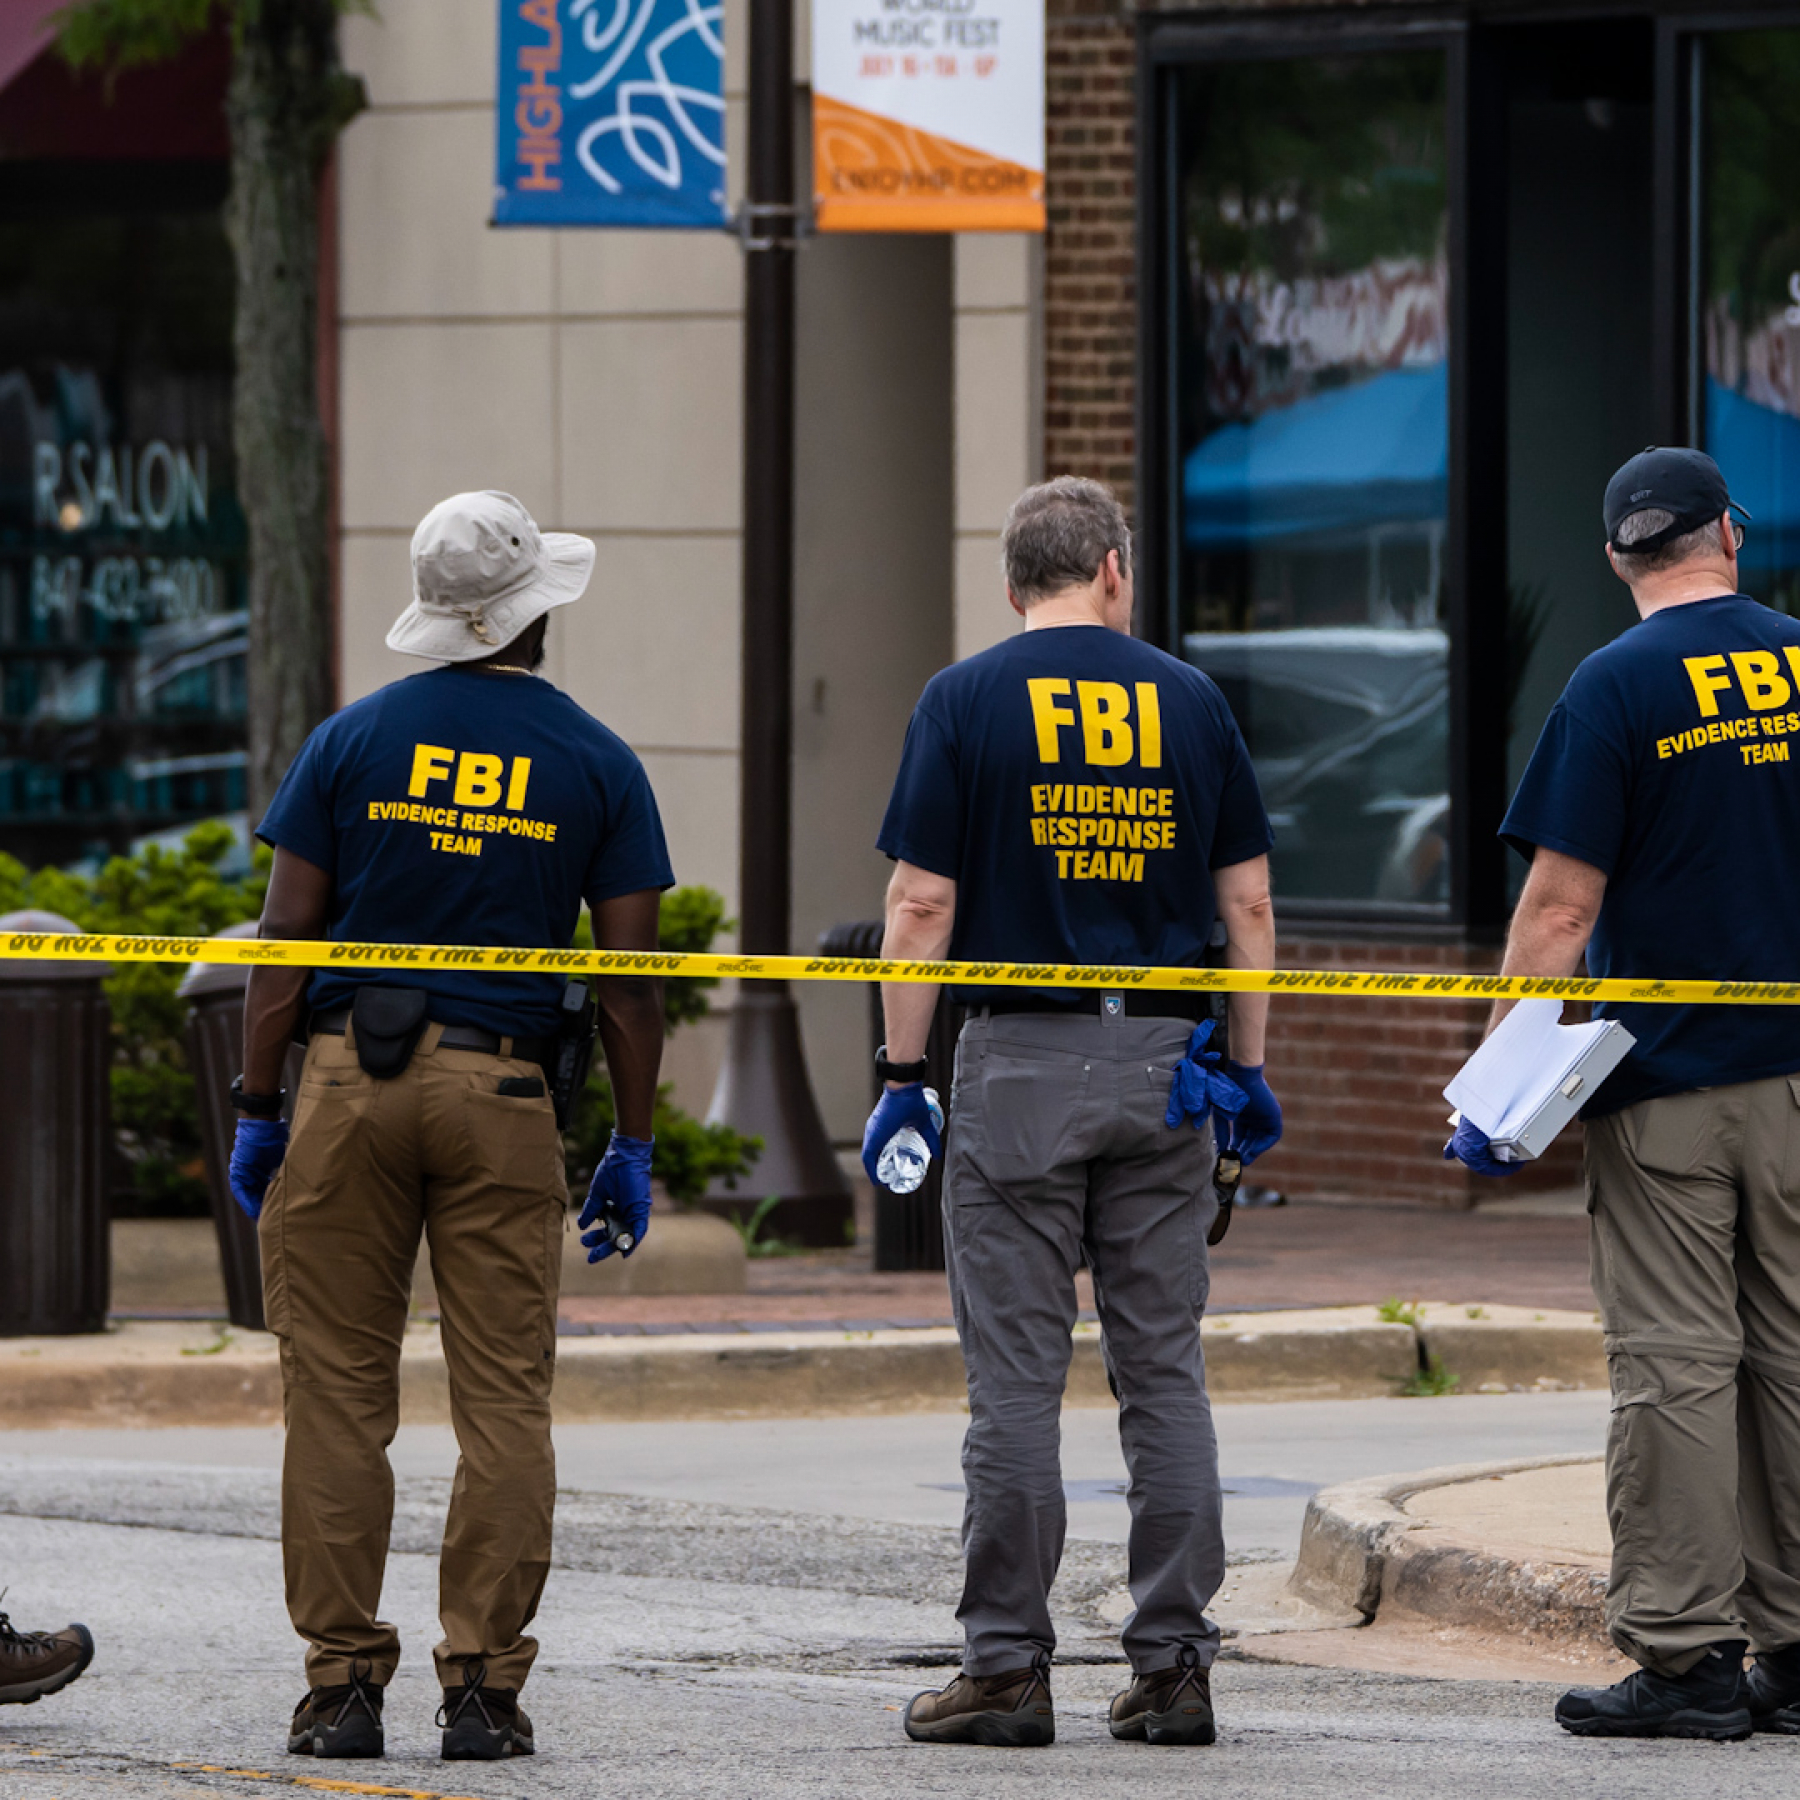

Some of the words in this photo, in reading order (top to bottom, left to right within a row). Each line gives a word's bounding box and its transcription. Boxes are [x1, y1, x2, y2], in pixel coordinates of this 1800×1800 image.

[853, 18, 935, 47] MUSIC
[943, 18, 999, 48] FEST
[1026, 677, 1162, 768] FBI
[1656, 717, 1758, 759] EVIDENCE
[1759, 712, 1800, 736] RES
[1740, 741, 1790, 765] TEAM
[408, 743, 532, 811] FBI
[1030, 784, 1174, 817] EVIDENCE
[368, 802, 459, 828] EVIDENCE
[461, 812, 558, 842] RESPONSE
[1030, 817, 1177, 850] RESPONSE
[430, 831, 483, 857] TEAM
[1055, 850, 1145, 882] TEAM
